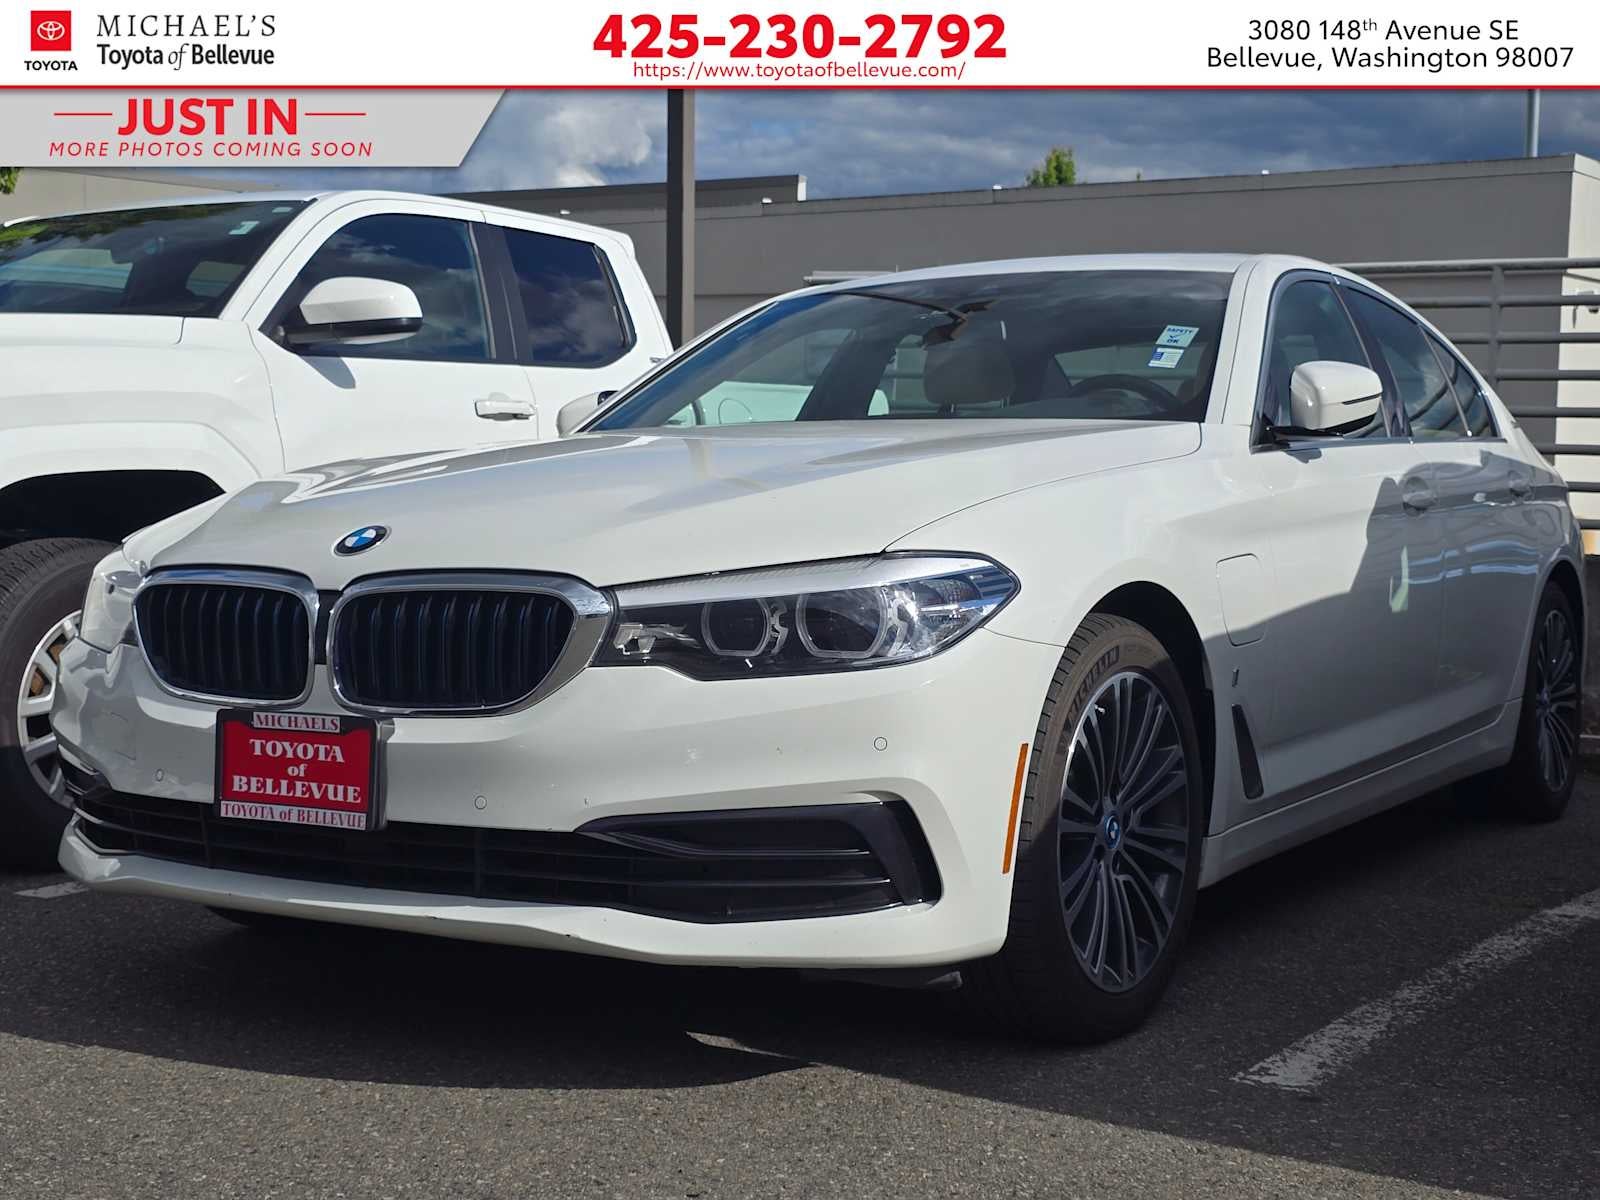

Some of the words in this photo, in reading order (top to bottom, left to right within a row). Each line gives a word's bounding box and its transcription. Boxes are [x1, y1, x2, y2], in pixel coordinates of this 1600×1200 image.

[255, 713, 339, 731] MICHAELS
[249, 739, 344, 762] TOYOTA
[287, 763, 308, 777] of
[232, 776, 361, 803] BELLEVUE
[222, 802, 275, 820] TOYOTA
[280, 808, 292, 821] of
[297, 809, 365, 829] BELLEVUE
